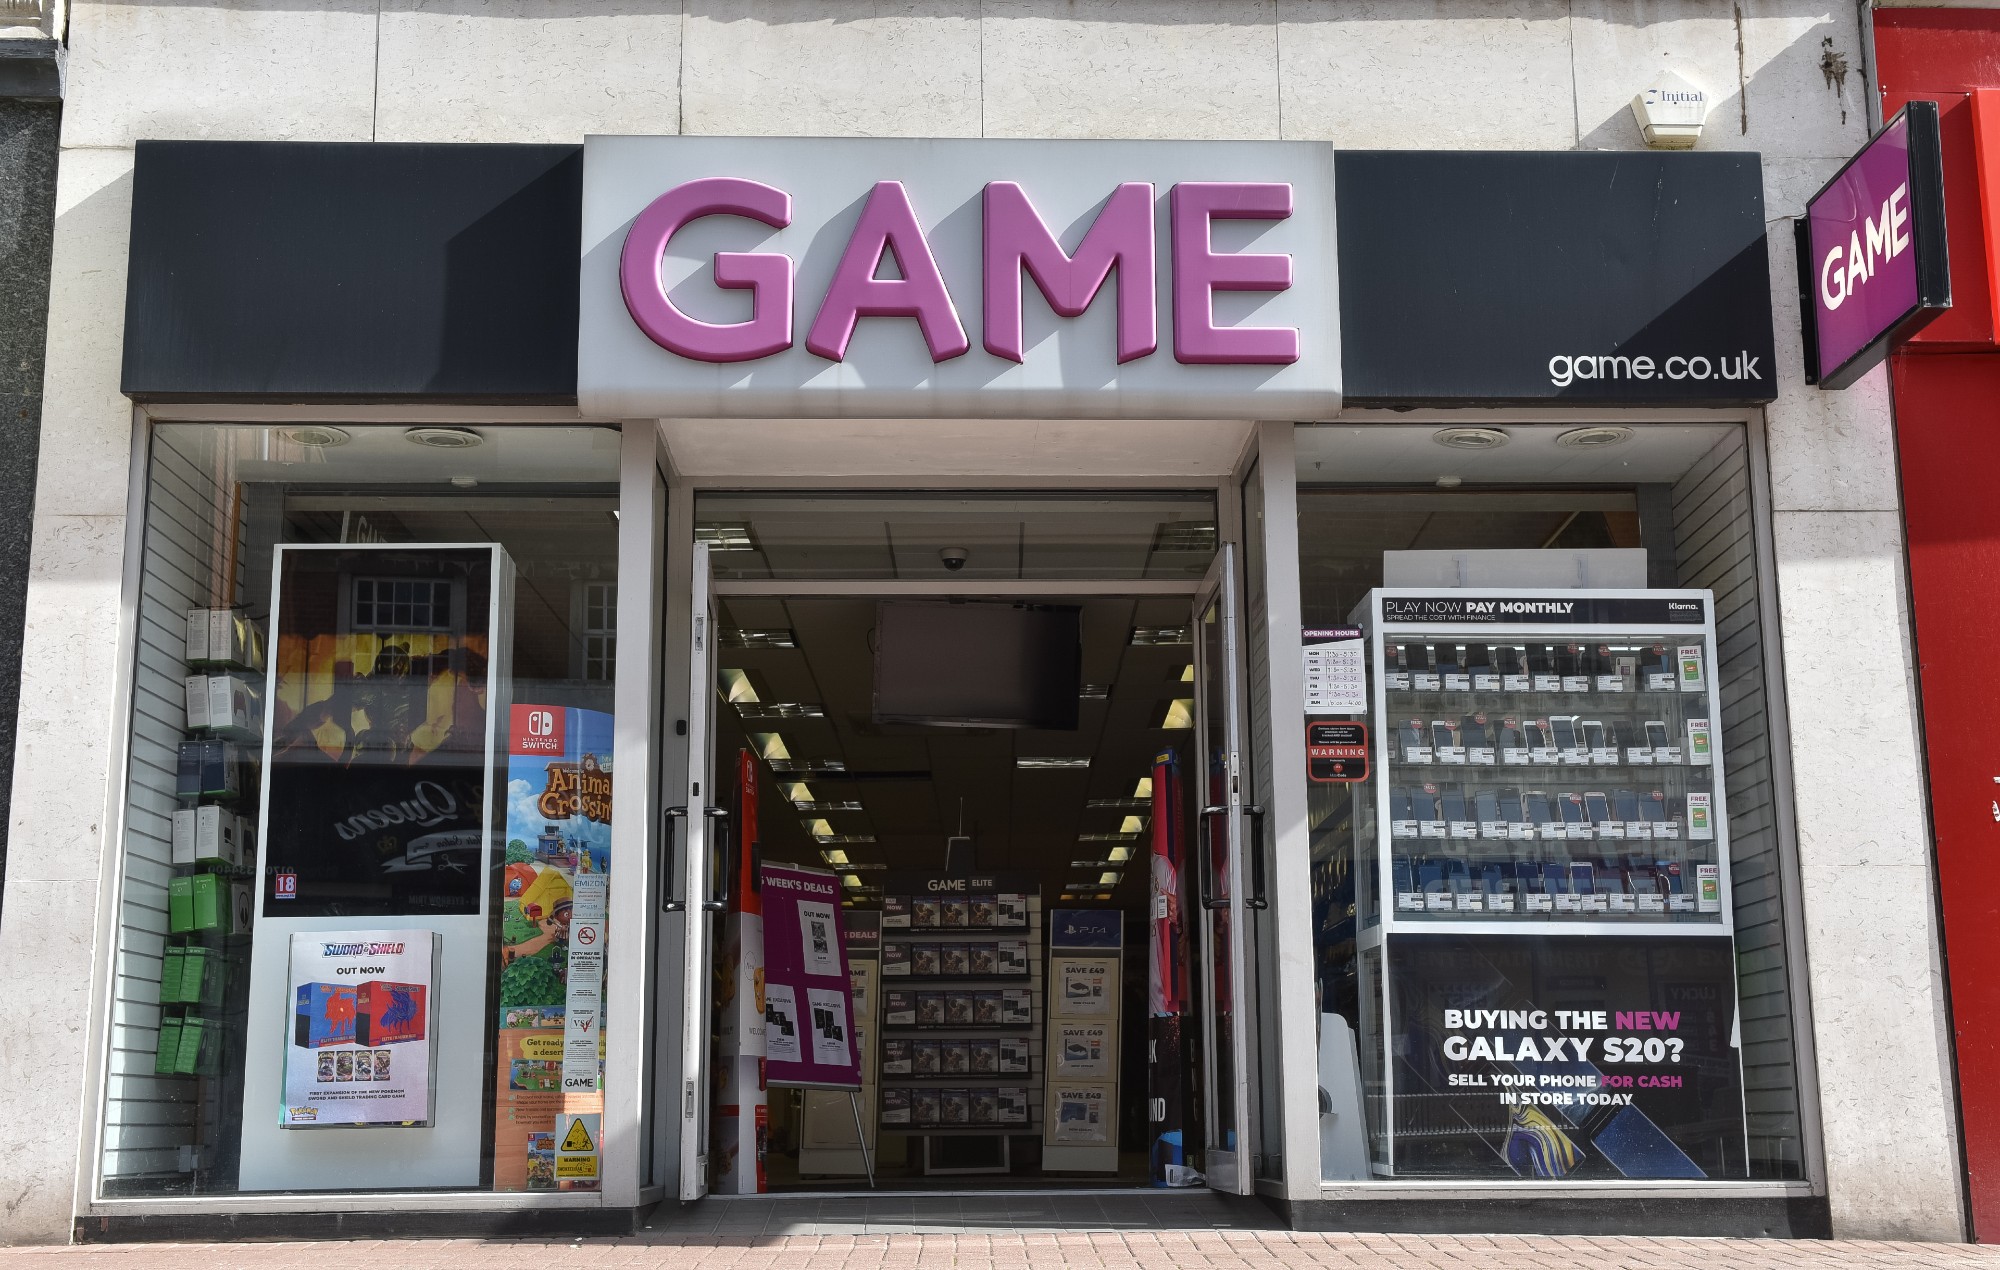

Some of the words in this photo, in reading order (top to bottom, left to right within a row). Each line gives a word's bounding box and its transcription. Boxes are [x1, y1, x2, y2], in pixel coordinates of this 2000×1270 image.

[1661, 89, 1703, 103] Initial
[1820, 182, 1909, 311] GAME
[620, 177, 1301, 366] GAME
[1549, 350, 1762, 387] game.co.uk
[1386, 602, 1423, 613] PLAY
[1425, 601, 1462, 613] NOW
[1466, 602, 1497, 614] PAY
[1500, 602, 1574, 614] MONTHLY
[550, 768, 612, 796] Anima
[278, 876, 295, 892] 18
[766, 876, 802, 891] WEEK'S
[804, 879, 834, 895] DEALS
[928, 880, 966, 891] GAME
[818, 911, 830, 919] NOW
[322, 942, 363, 957] SWORD
[368, 942, 405, 956] SHIELD
[1445, 1009, 1547, 1030] BUYING
[1555, 1010, 1606, 1030] THE
[1615, 1011, 1681, 1030] NEW
[1443, 1036, 1594, 1062] GALAXY
[1603, 1037, 1684, 1063] S20?
[565, 1078, 594, 1087] GAME
[1448, 1073, 1486, 1087] SELL
[1490, 1074, 1535, 1087] YOUR
[1540, 1074, 1596, 1087] PHONE
[1602, 1075, 1634, 1088] FOR
[1638, 1075, 1682, 1088] CASH
[1500, 1092, 1517, 1105] IN
[1520, 1092, 1574, 1105] STORE
[1577, 1092, 1633, 1105] TODAY
